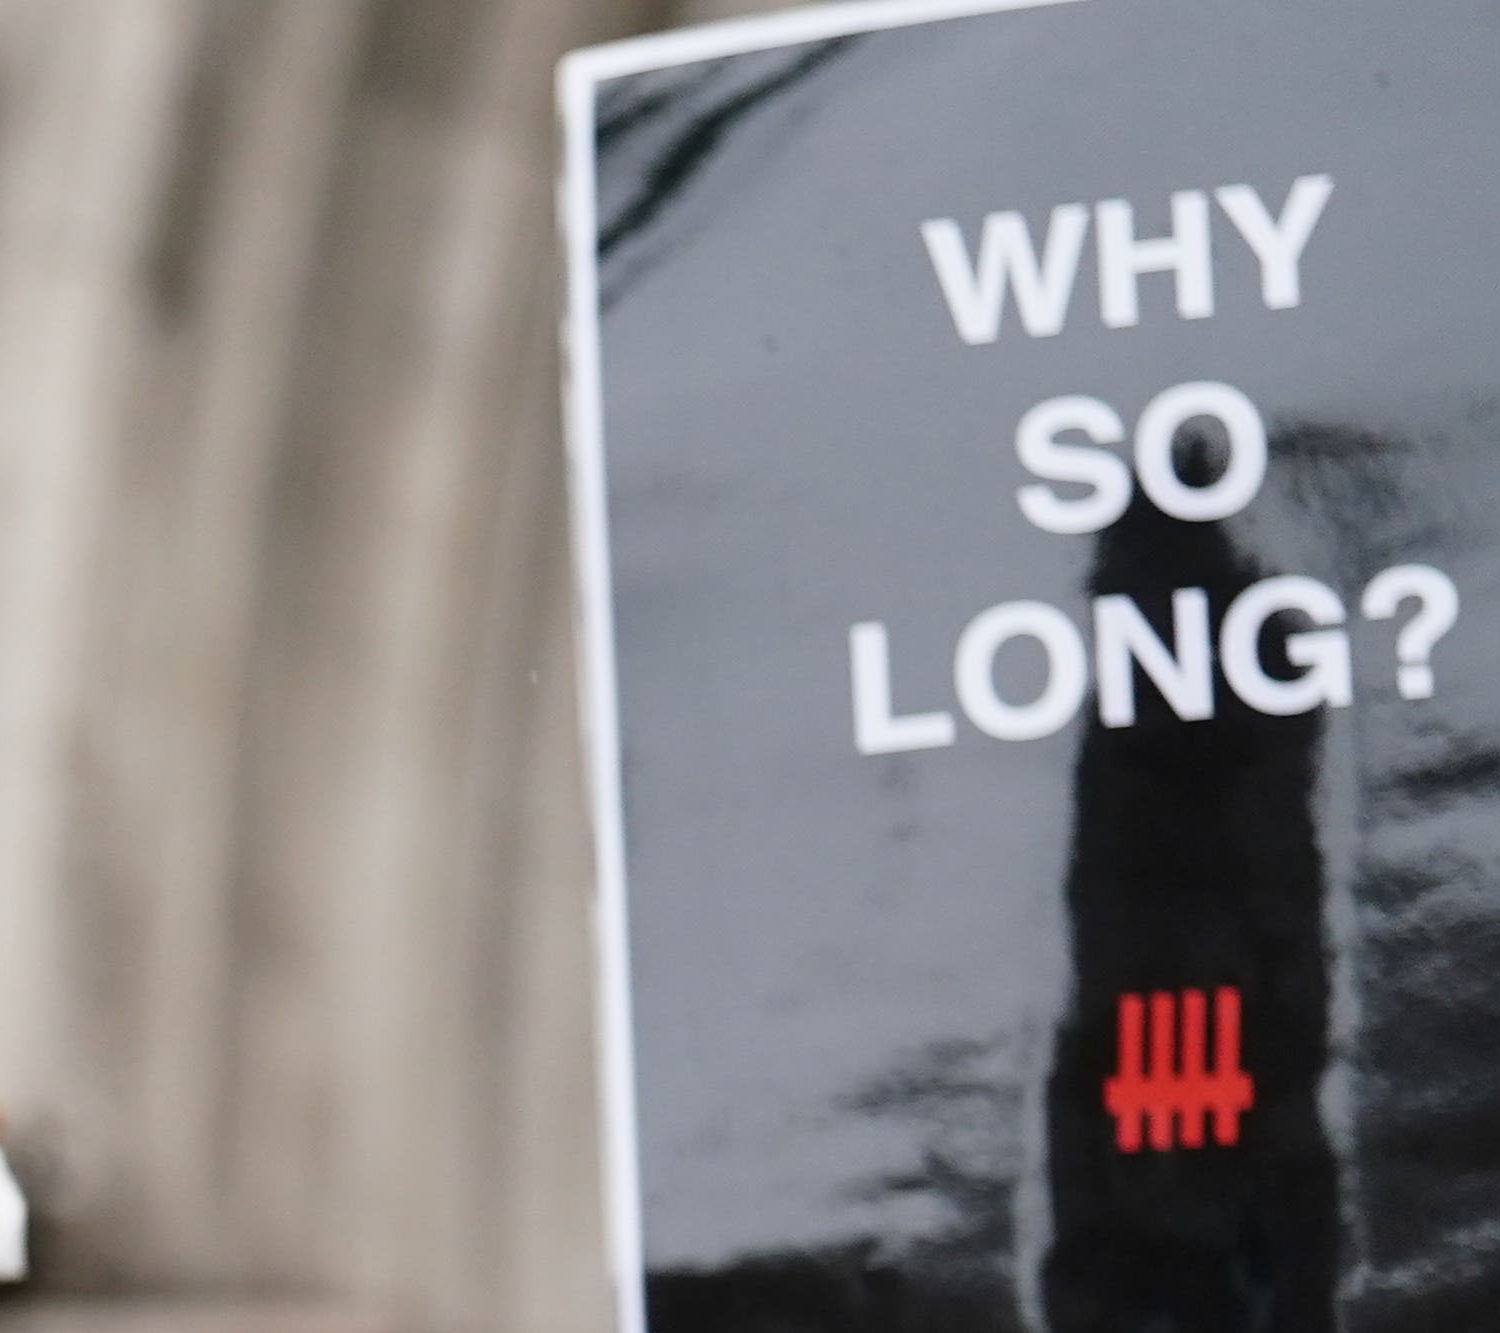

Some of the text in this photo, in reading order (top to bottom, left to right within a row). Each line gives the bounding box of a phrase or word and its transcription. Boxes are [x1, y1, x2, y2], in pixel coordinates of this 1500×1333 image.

[922, 174, 1333, 346] WHY
[1016, 381, 1265, 534] SO
[850, 566, 1457, 754] LONG?
